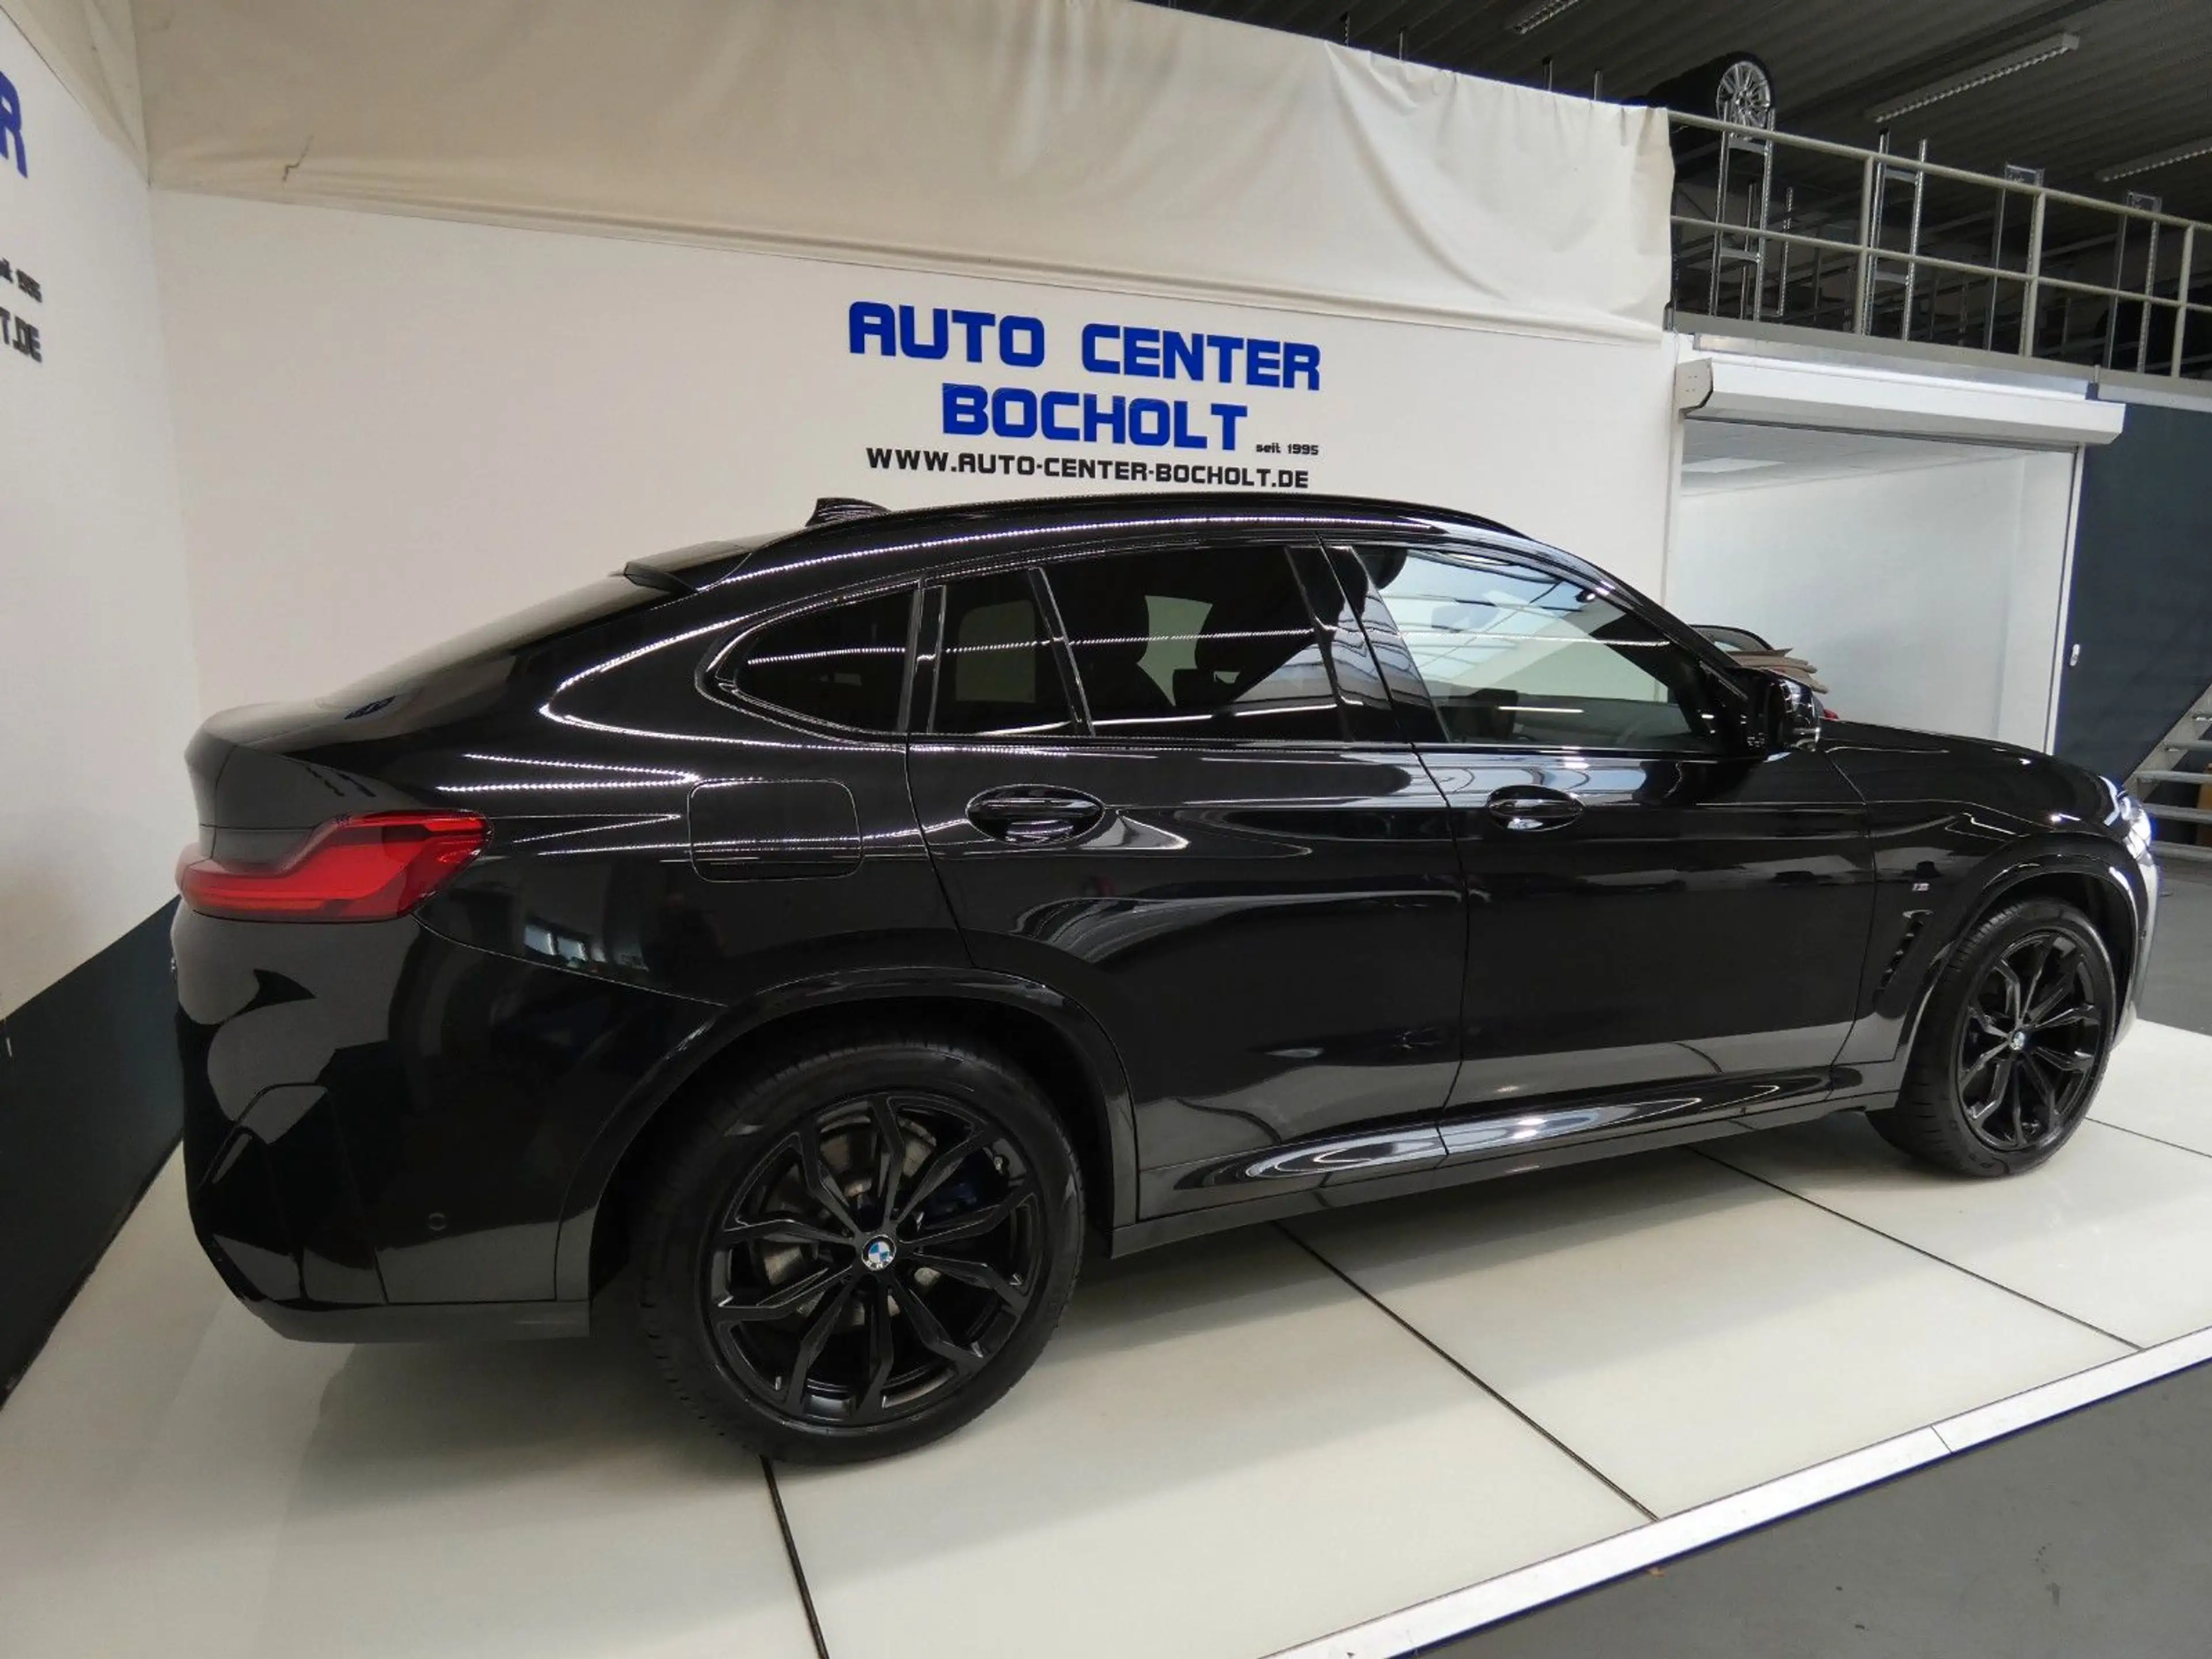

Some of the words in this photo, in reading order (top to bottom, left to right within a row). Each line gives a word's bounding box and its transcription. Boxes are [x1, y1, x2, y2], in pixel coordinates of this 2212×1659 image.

[849, 301, 1046, 368] AUTO
[1082, 323, 1321, 391] CENTER
[942, 382, 1248, 452] BOCHOLT
[866, 448, 1309, 489] WWW.AUTO-CENTER-BOCHOLT.DE
[1256, 442, 1282, 453] seit
[1287, 443, 1319, 456] 1995
